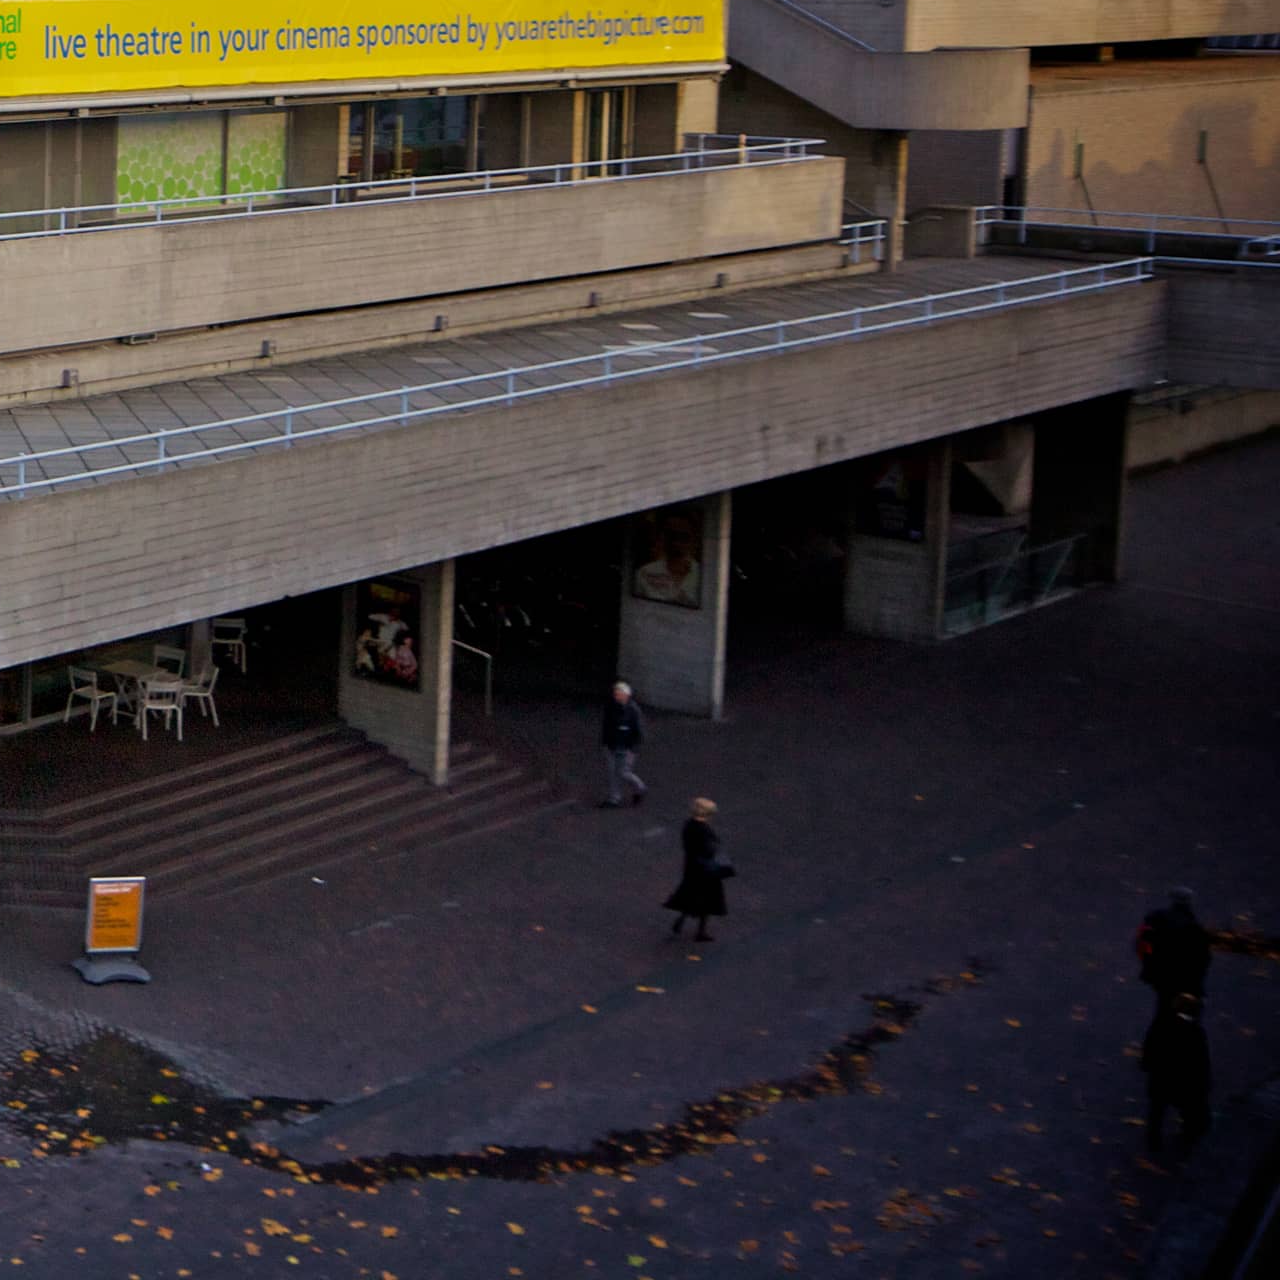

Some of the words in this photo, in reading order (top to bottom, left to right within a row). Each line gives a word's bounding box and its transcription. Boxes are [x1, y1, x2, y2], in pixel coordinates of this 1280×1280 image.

[44, 25, 87, 59] live
[95, 23, 183, 58] theatre
[191, 21, 211, 54] in
[218, 28, 270, 61] your
[276, 19, 351, 51] cinema
[356, 14, 461, 55] sponsored
[467, 13, 489, 51] by
